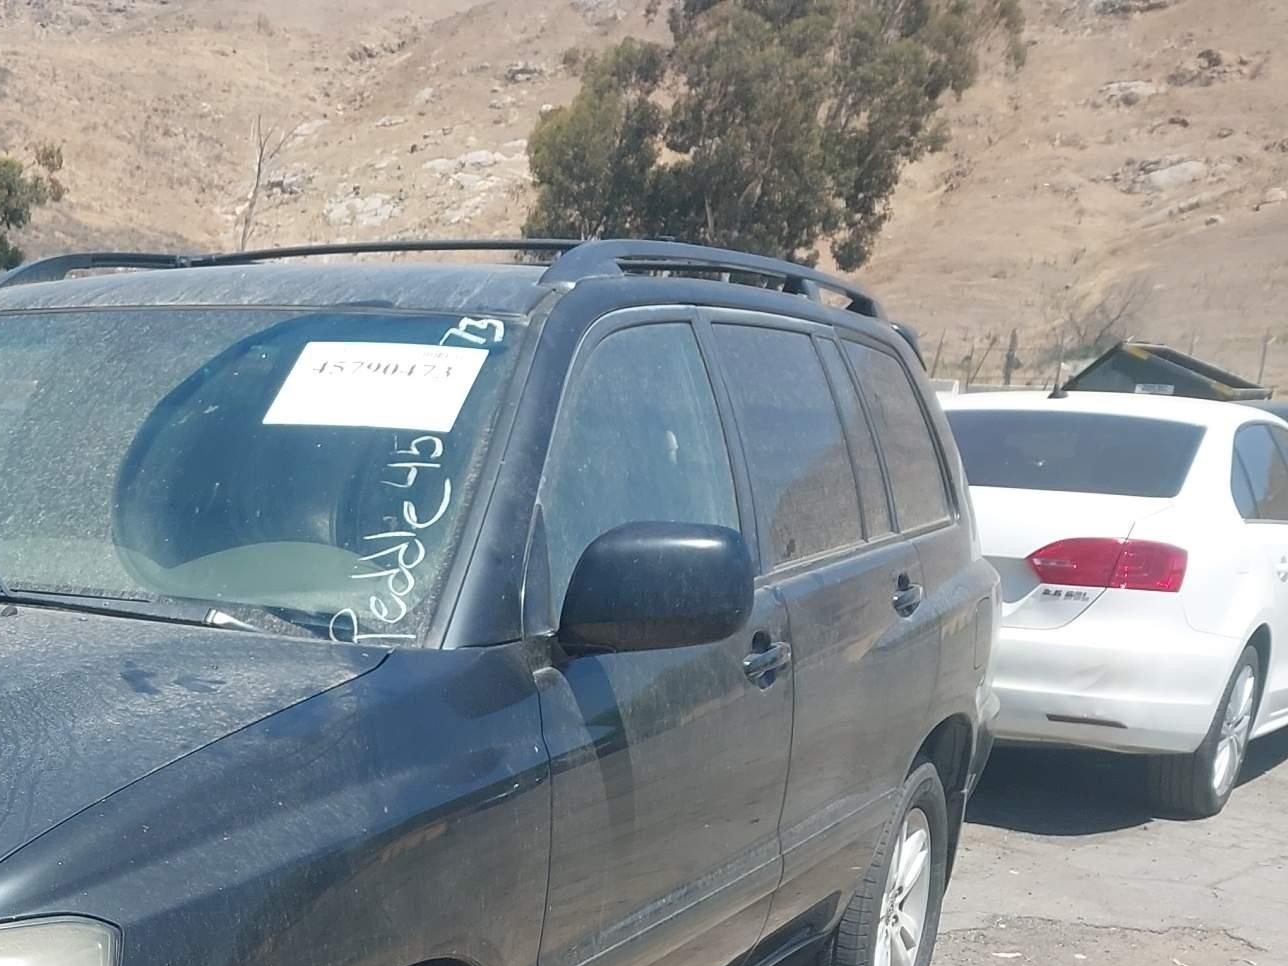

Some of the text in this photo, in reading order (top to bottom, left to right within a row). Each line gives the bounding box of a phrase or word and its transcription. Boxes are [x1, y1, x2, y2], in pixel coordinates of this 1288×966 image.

[312, 360, 454, 378] 45790473
[380, 432, 444, 488] 45
[329, 477, 452, 643] Peddle
